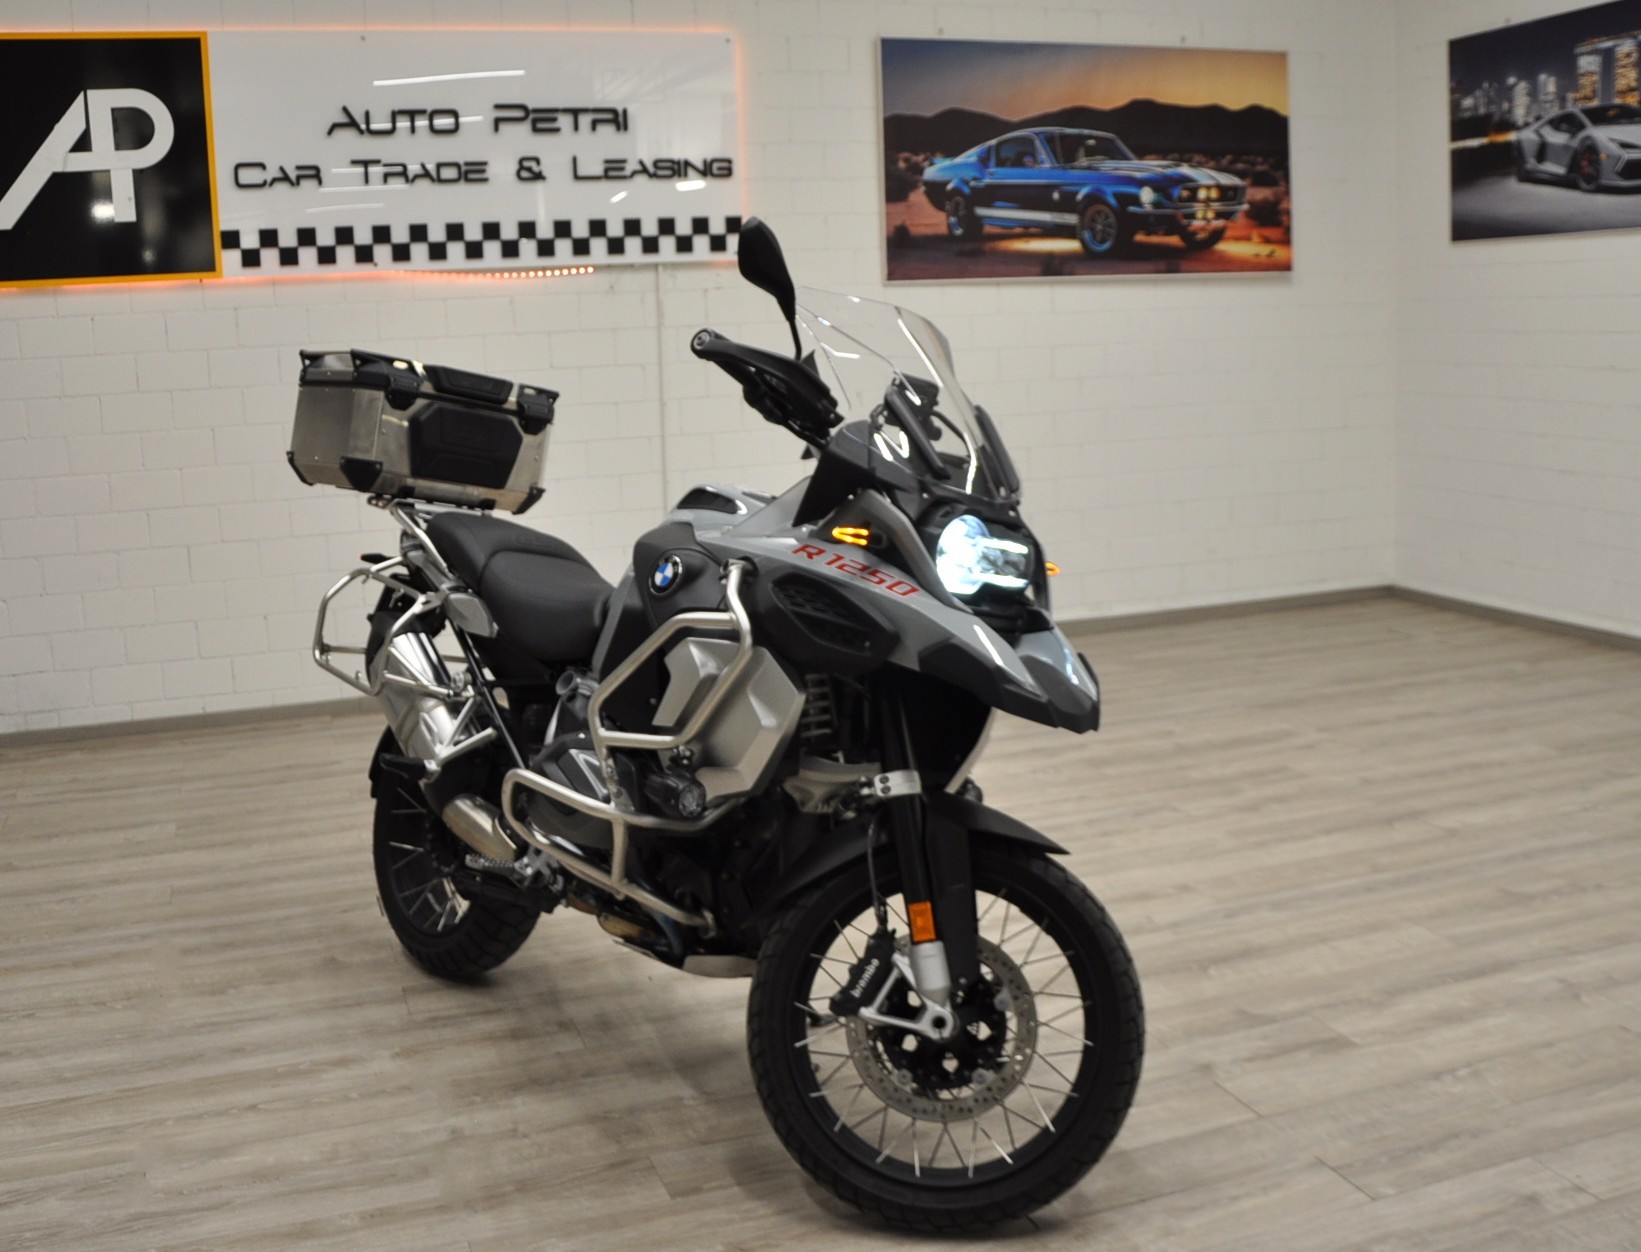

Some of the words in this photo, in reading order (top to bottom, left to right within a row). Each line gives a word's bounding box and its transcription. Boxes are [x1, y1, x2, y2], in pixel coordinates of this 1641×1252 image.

[327, 105, 460, 136] AUTO
[494, 104, 628, 133] PETRI
[0, 88, 175, 230] AP
[234, 162, 323, 189] CAR
[350, 159, 489, 184] TRADE
[516, 156, 547, 181] &
[573, 155, 733, 180] LEASING
